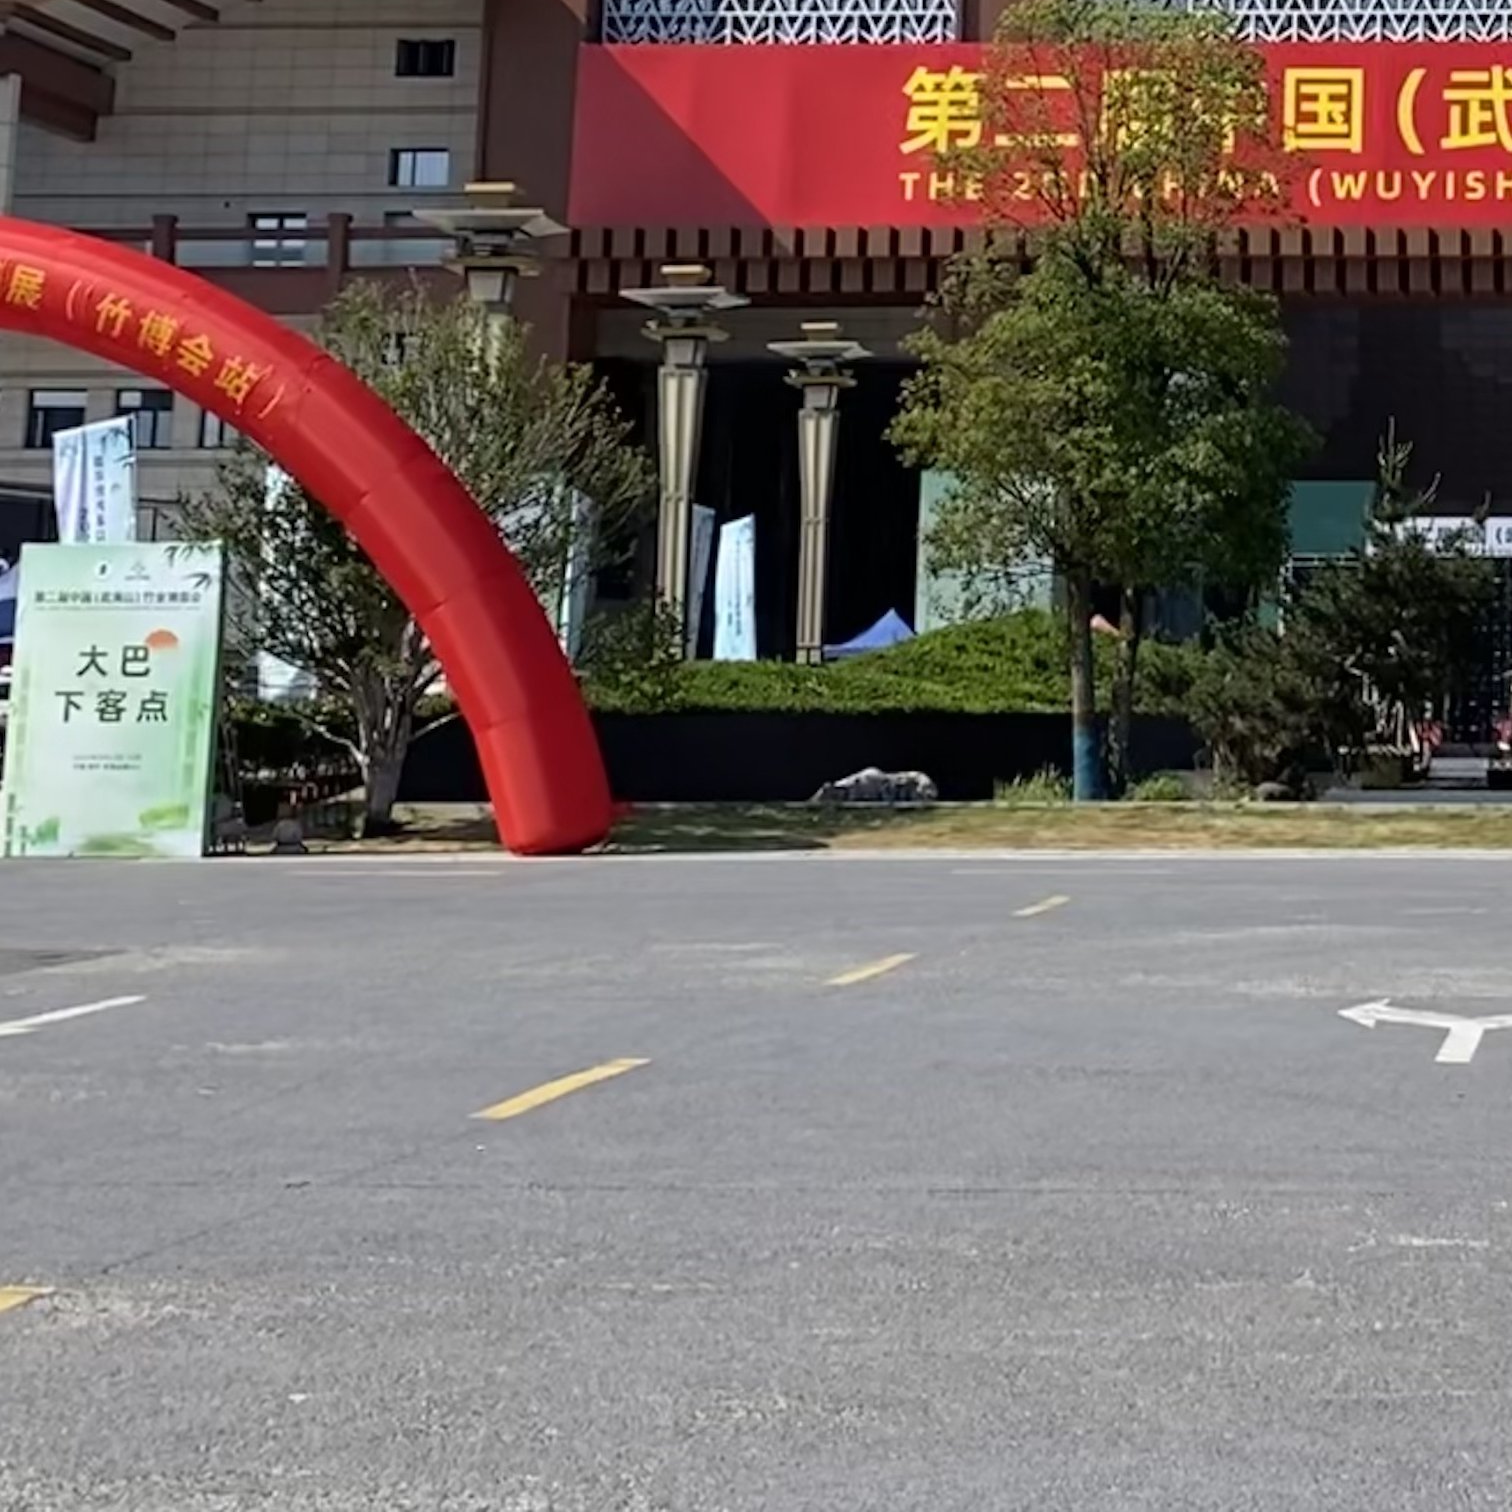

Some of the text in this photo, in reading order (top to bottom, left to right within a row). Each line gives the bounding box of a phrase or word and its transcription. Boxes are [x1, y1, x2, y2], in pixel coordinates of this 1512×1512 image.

[899, 171, 985, 200] THE
[76, 644, 151, 677] 大巴
[54, 688, 168, 723] 下客点
